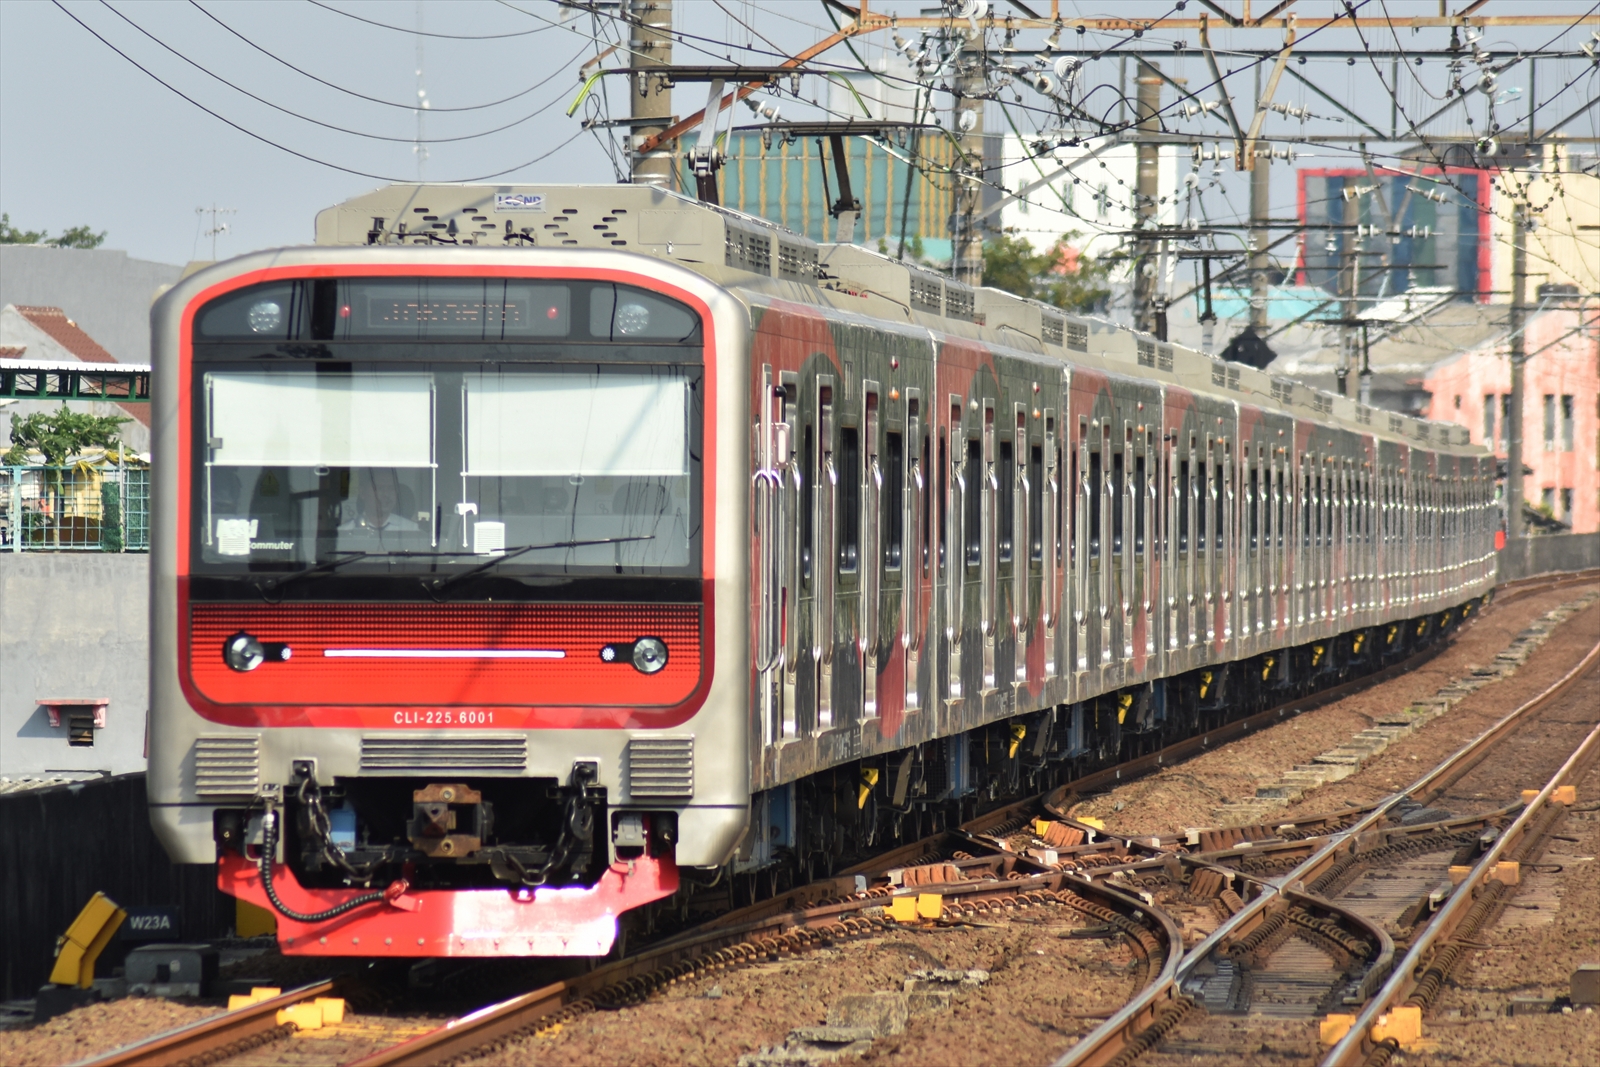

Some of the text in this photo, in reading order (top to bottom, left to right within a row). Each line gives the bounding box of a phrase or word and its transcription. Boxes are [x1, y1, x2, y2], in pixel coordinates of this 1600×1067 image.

[249, 541, 294, 549] ommuter
[393, 711, 493, 724] CLI-225.6001
[130, 915, 170, 930] W23A
